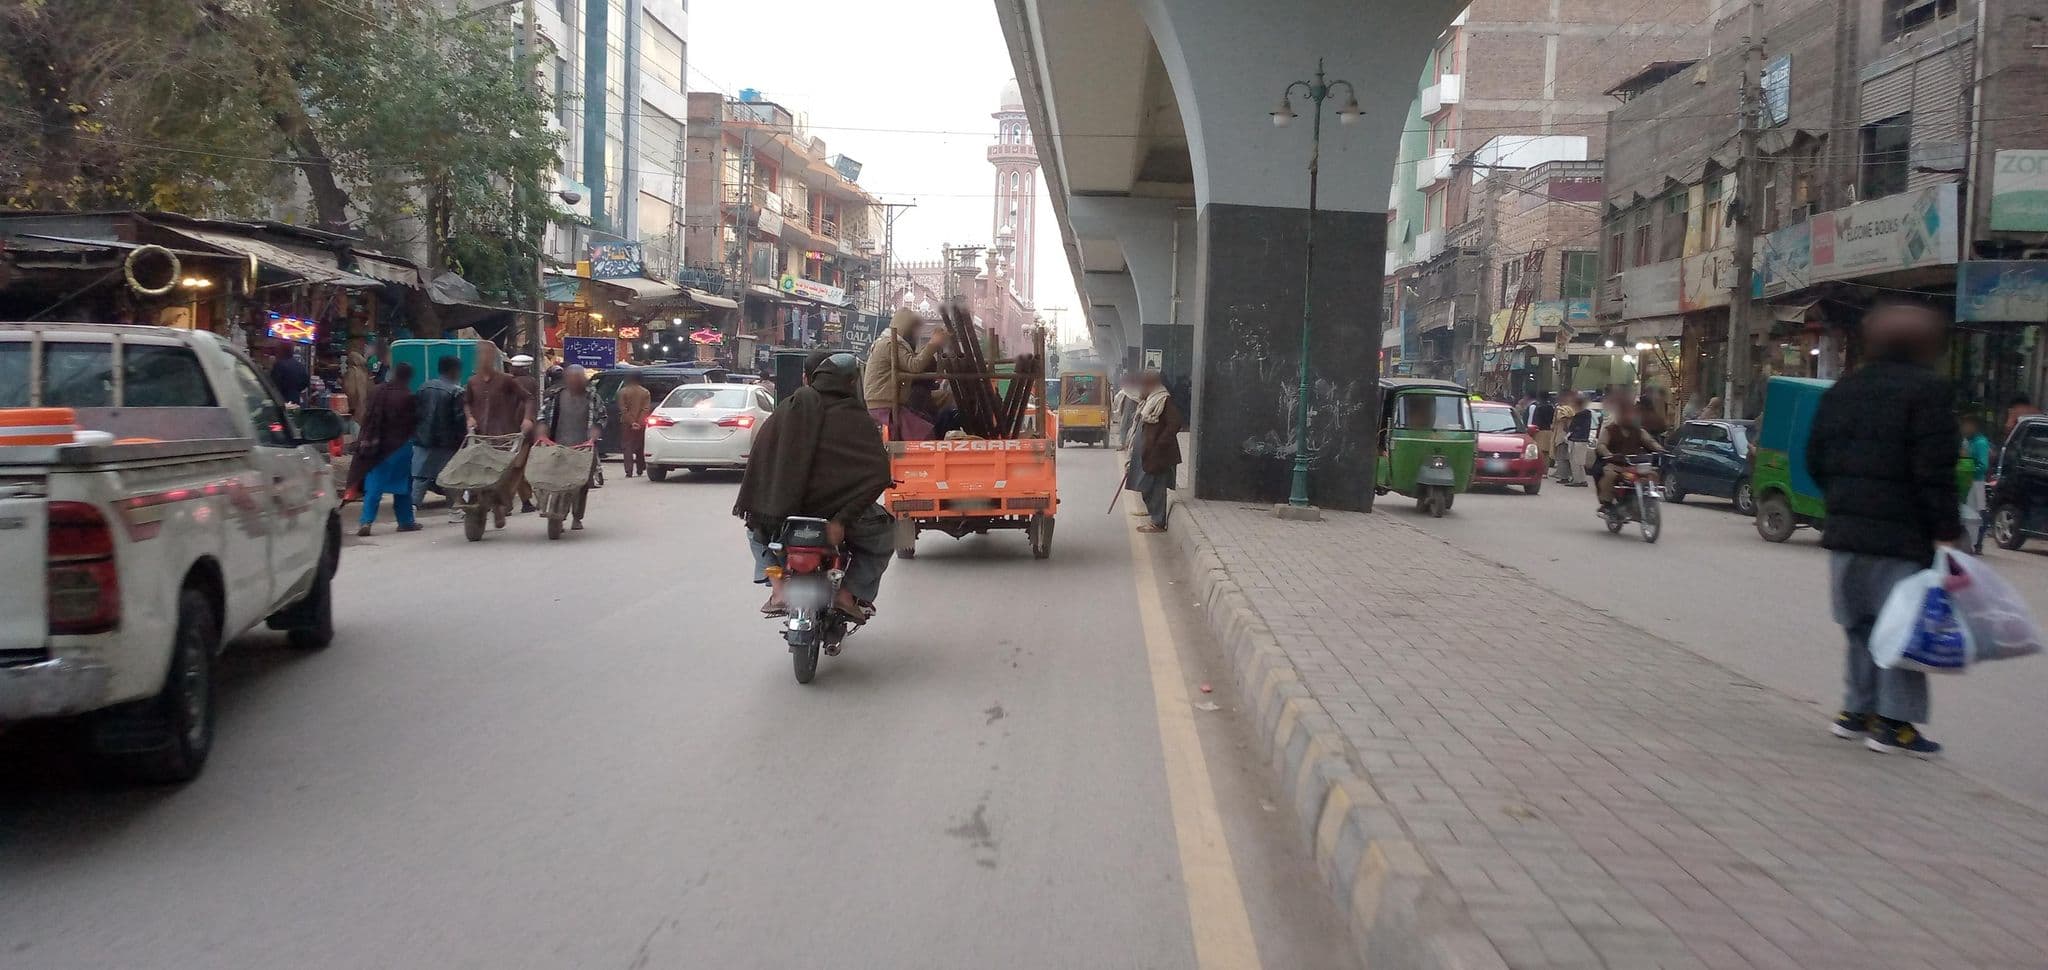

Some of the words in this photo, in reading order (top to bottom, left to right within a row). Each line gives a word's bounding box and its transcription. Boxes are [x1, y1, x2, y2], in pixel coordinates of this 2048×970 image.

[1874, 217, 1899, 237] BOOKS
[852, 322, 870, 332] Hotel
[845, 330, 872, 344] QALA
[919, 440, 1021, 452] SAZGAR
